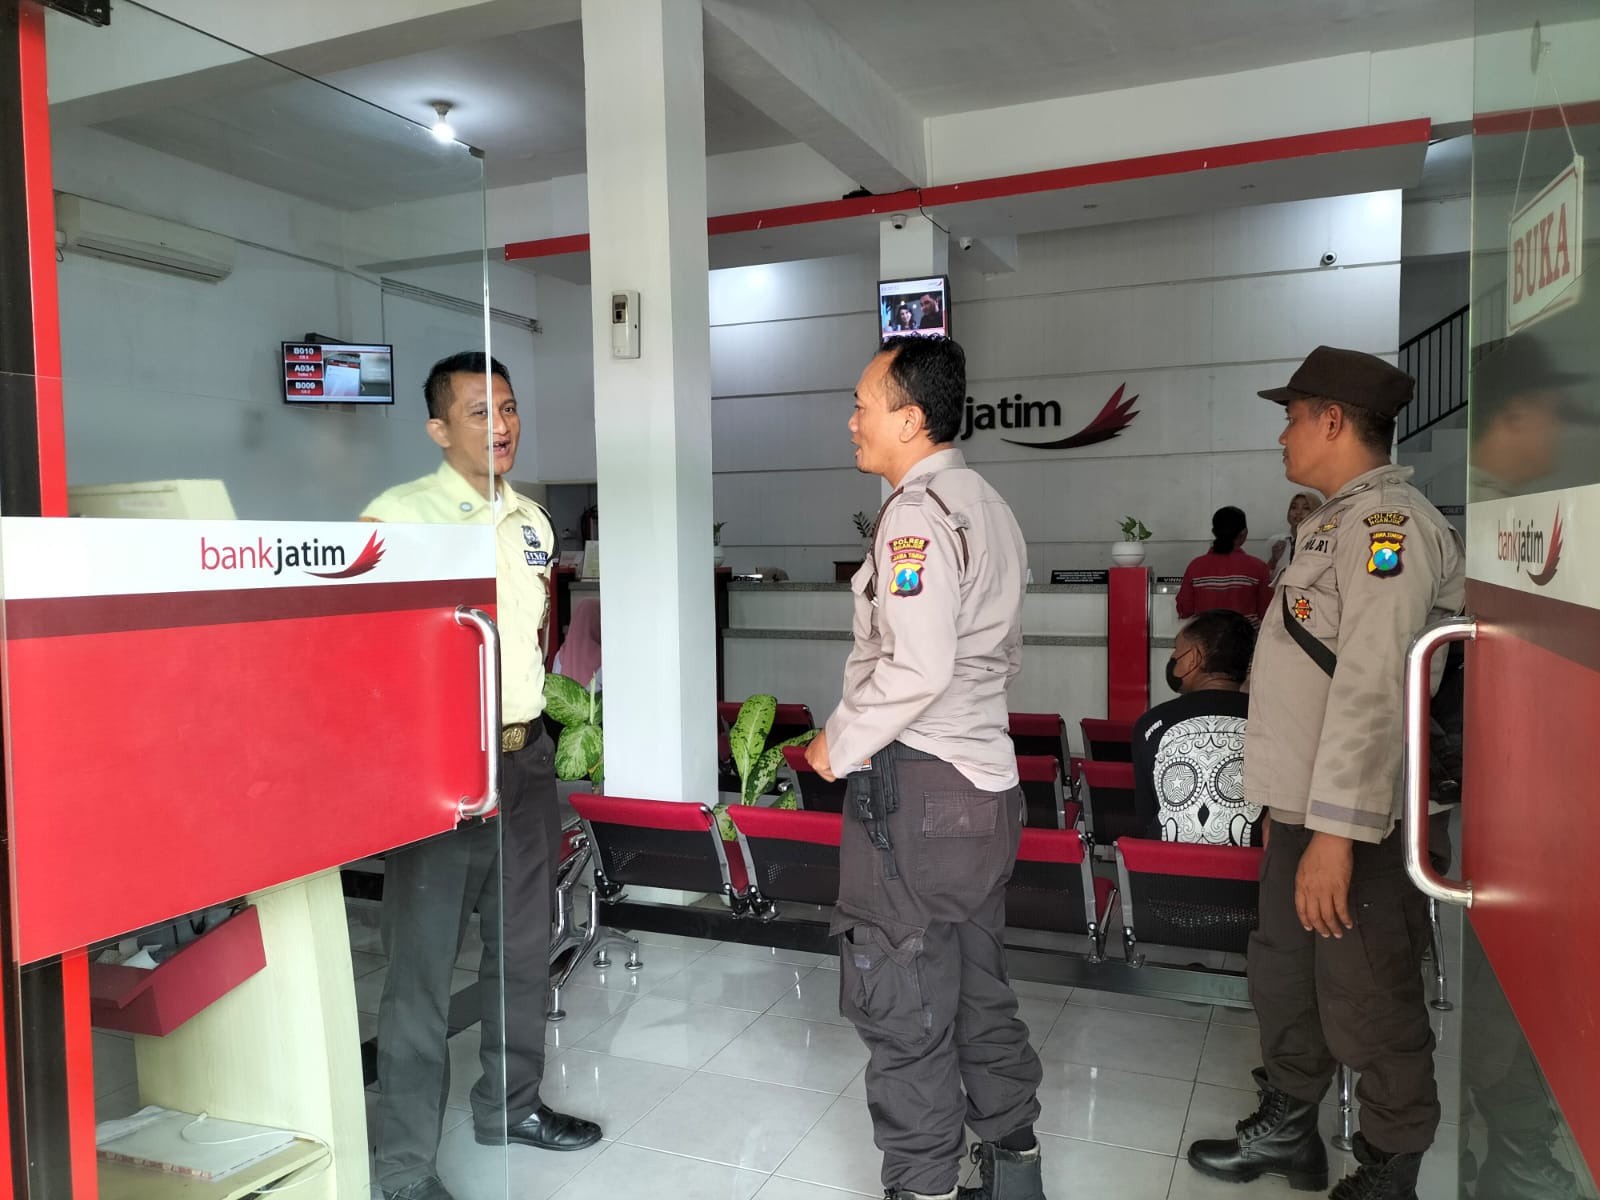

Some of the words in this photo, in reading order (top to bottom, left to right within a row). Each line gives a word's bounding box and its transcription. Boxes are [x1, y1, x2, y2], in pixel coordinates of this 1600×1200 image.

[1512, 203, 1570, 304] BUKA
[293, 347, 314, 355] B010
[294, 364, 315, 372] A034
[960, 393, 1062, 441] jatim
[201, 536, 346, 576] bankjatim
[1497, 518, 1544, 573] bankjatim
